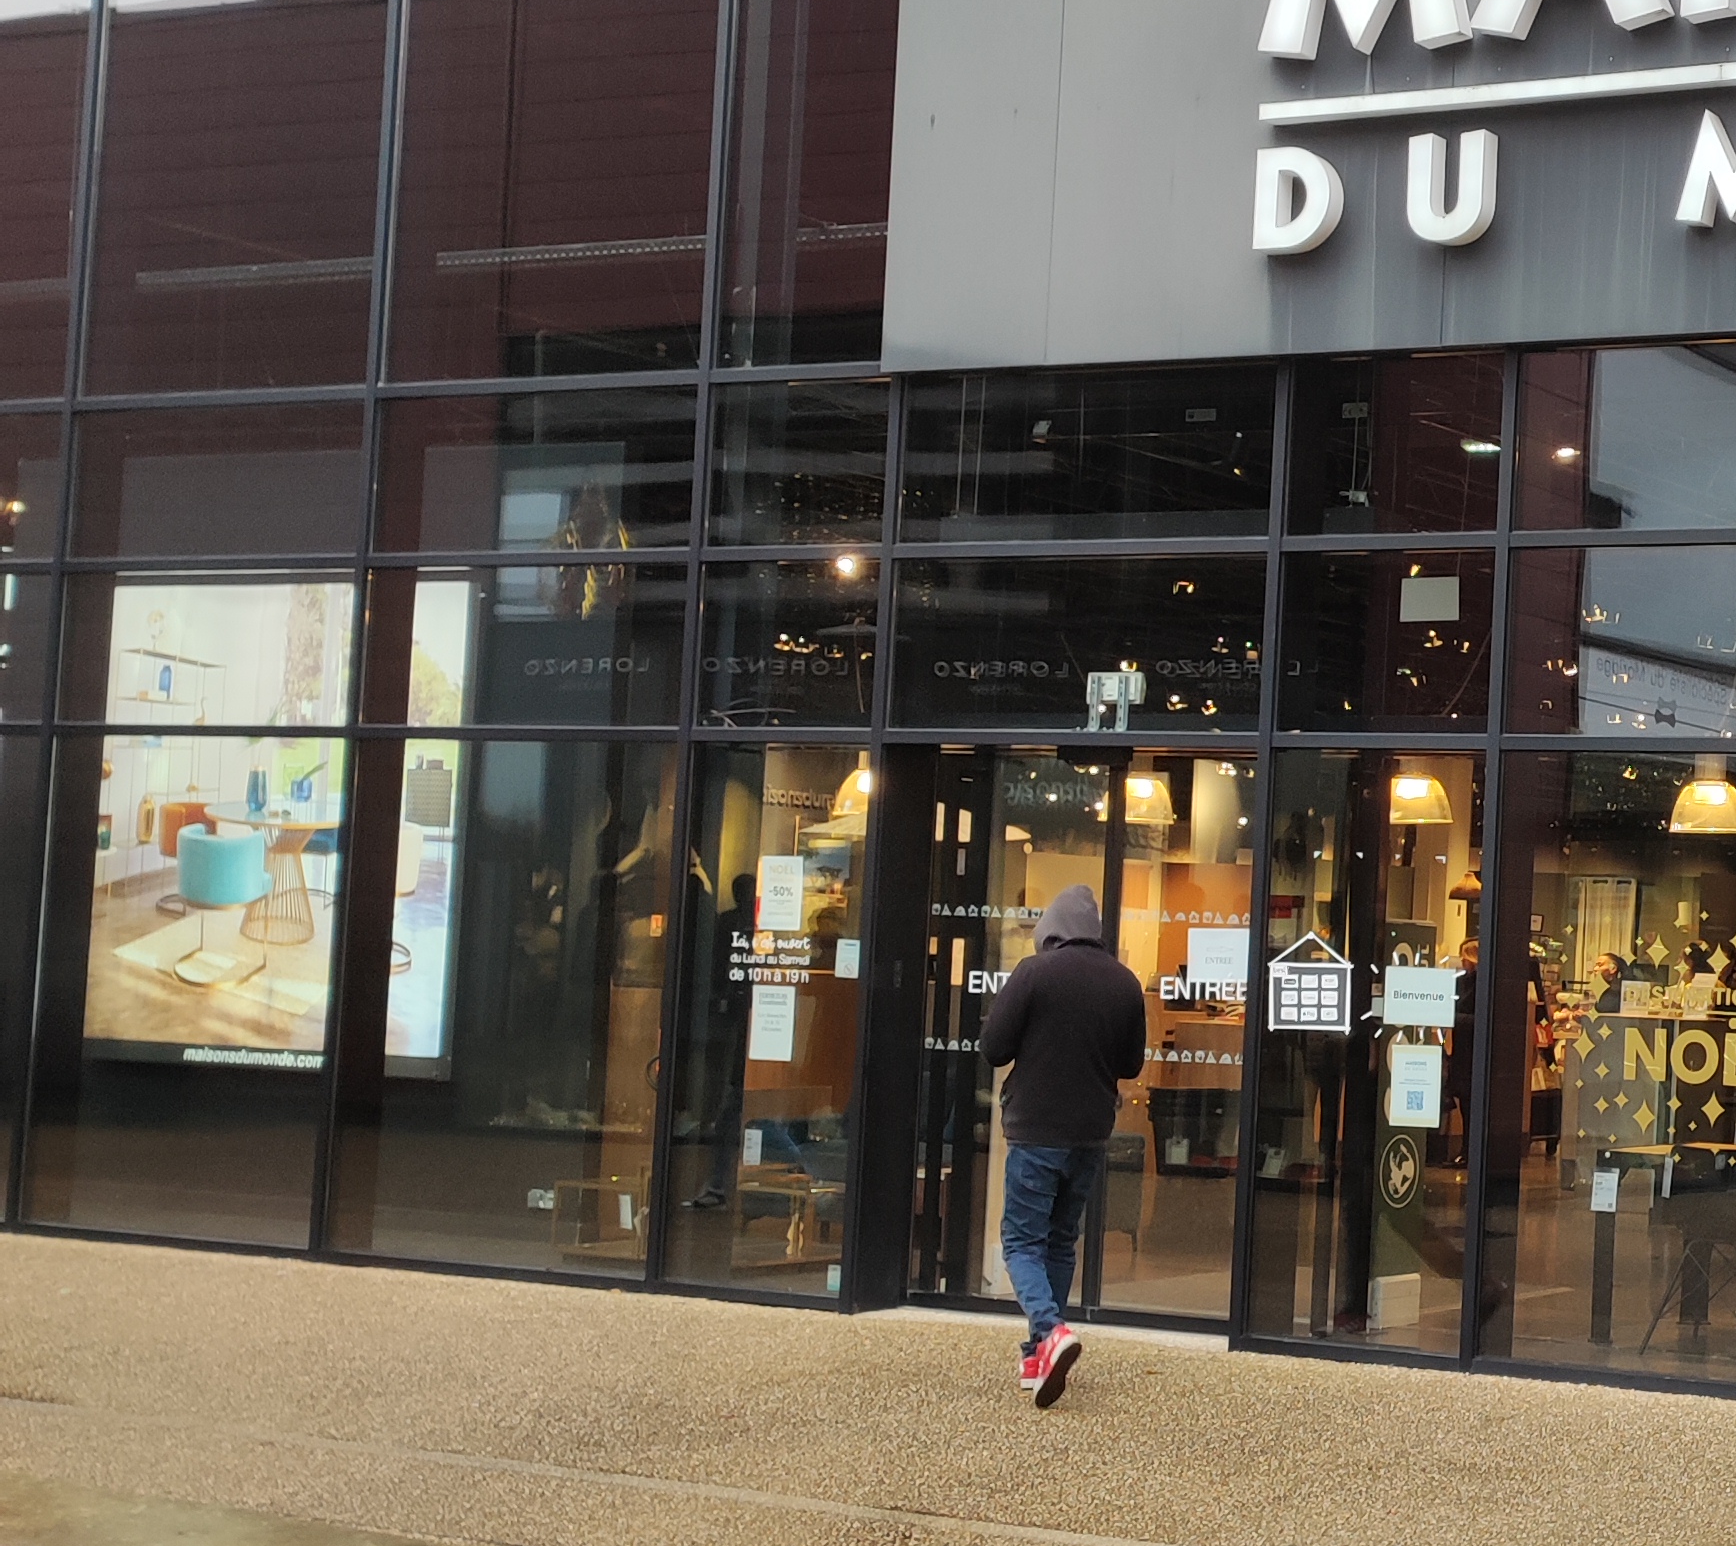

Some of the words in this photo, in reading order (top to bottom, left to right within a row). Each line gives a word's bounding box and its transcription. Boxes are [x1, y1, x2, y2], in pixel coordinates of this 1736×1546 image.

[1252, 127, 1498, 254] DU
[768, 885, 794, 897] -50%
[731, 931, 750, 950] Ici,
[776, 936, 811, 951] ouvert
[729, 953, 742, 964] du
[743, 953, 766, 965] Lundi
[767, 955, 778, 965] au
[779, 953, 811, 966] Samedi
[728, 966, 745, 982] de
[748, 967, 762, 981] 10
[773, 967, 783, 983] à
[785, 968, 800, 984] 19
[801, 969, 810, 984] h
[967, 970, 1014, 995] ENT
[1159, 972, 1248, 1001] ENTRÉE
[1392, 989, 1445, 1002] Bienvenue
